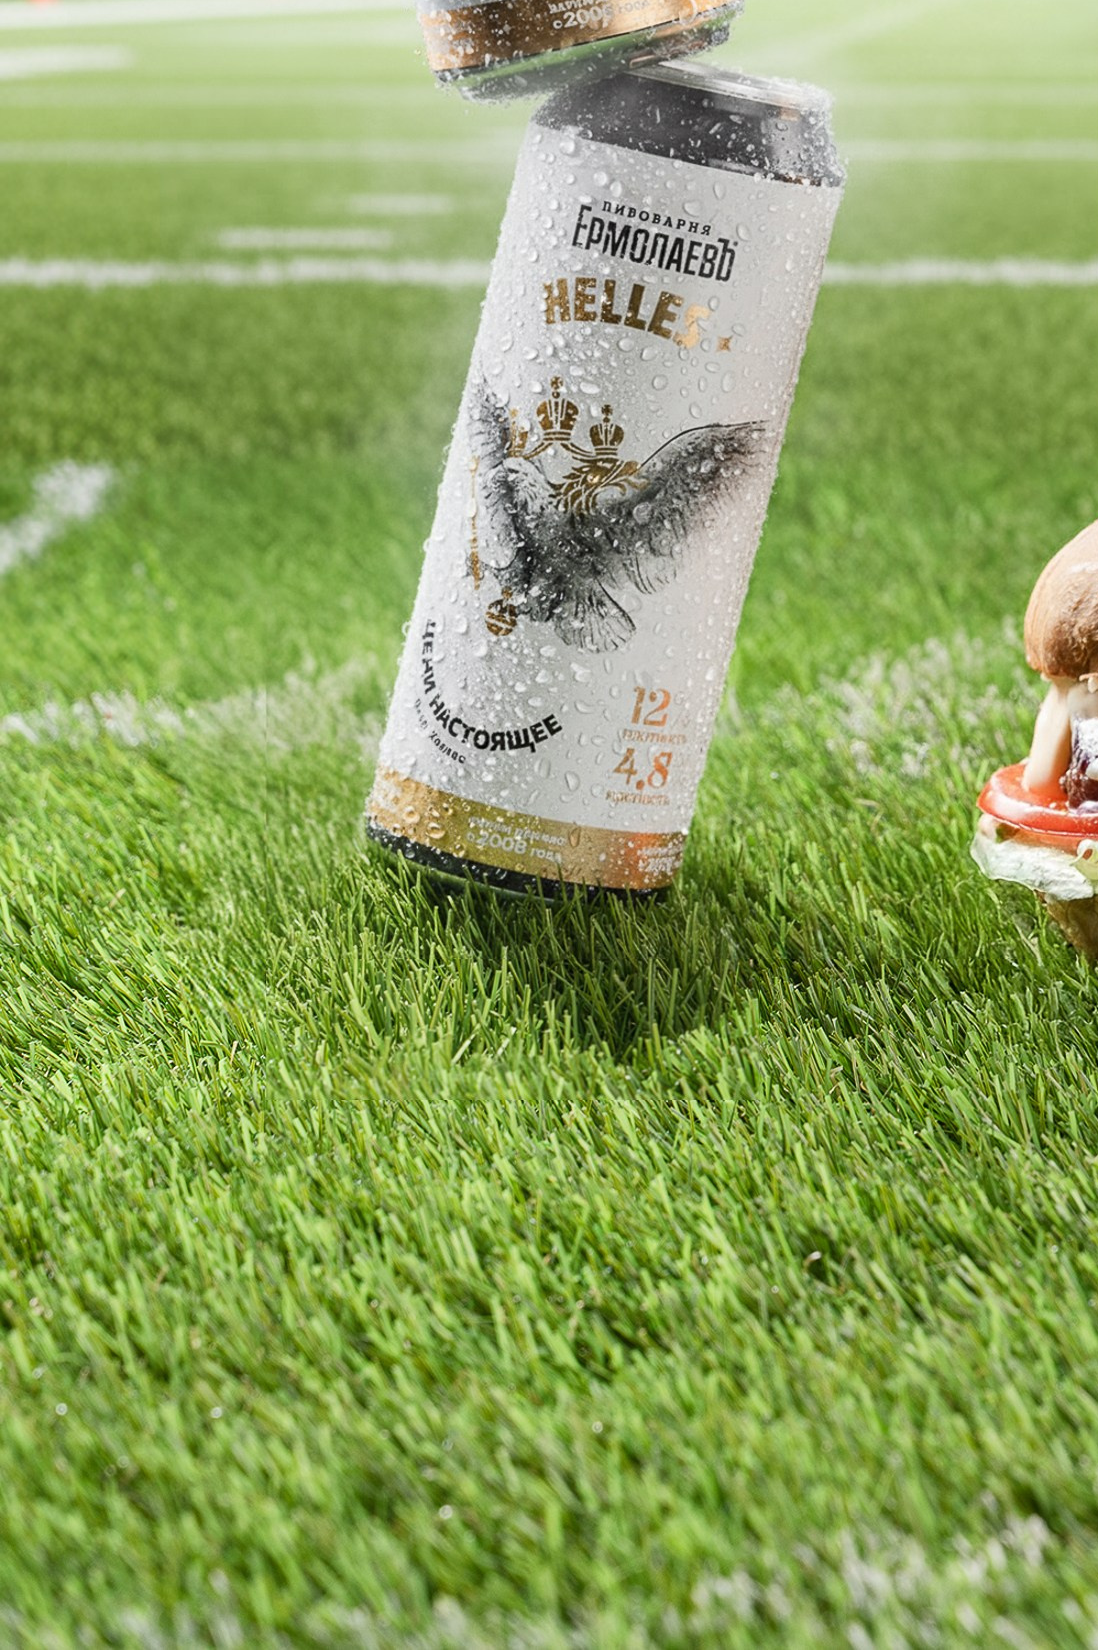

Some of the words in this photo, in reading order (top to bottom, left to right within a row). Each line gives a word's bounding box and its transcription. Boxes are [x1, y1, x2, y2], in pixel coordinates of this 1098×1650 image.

[602, 201, 712, 236] ПИВОВАРНЯ
[543, 277, 711, 349] HELLES
[422, 619, 436, 694] ЦЕНИ
[428, 693, 563, 753] НАСТОЯЩЕЕ
[631, 686, 671, 727] 12
[613, 748, 672, 791] 4.8
